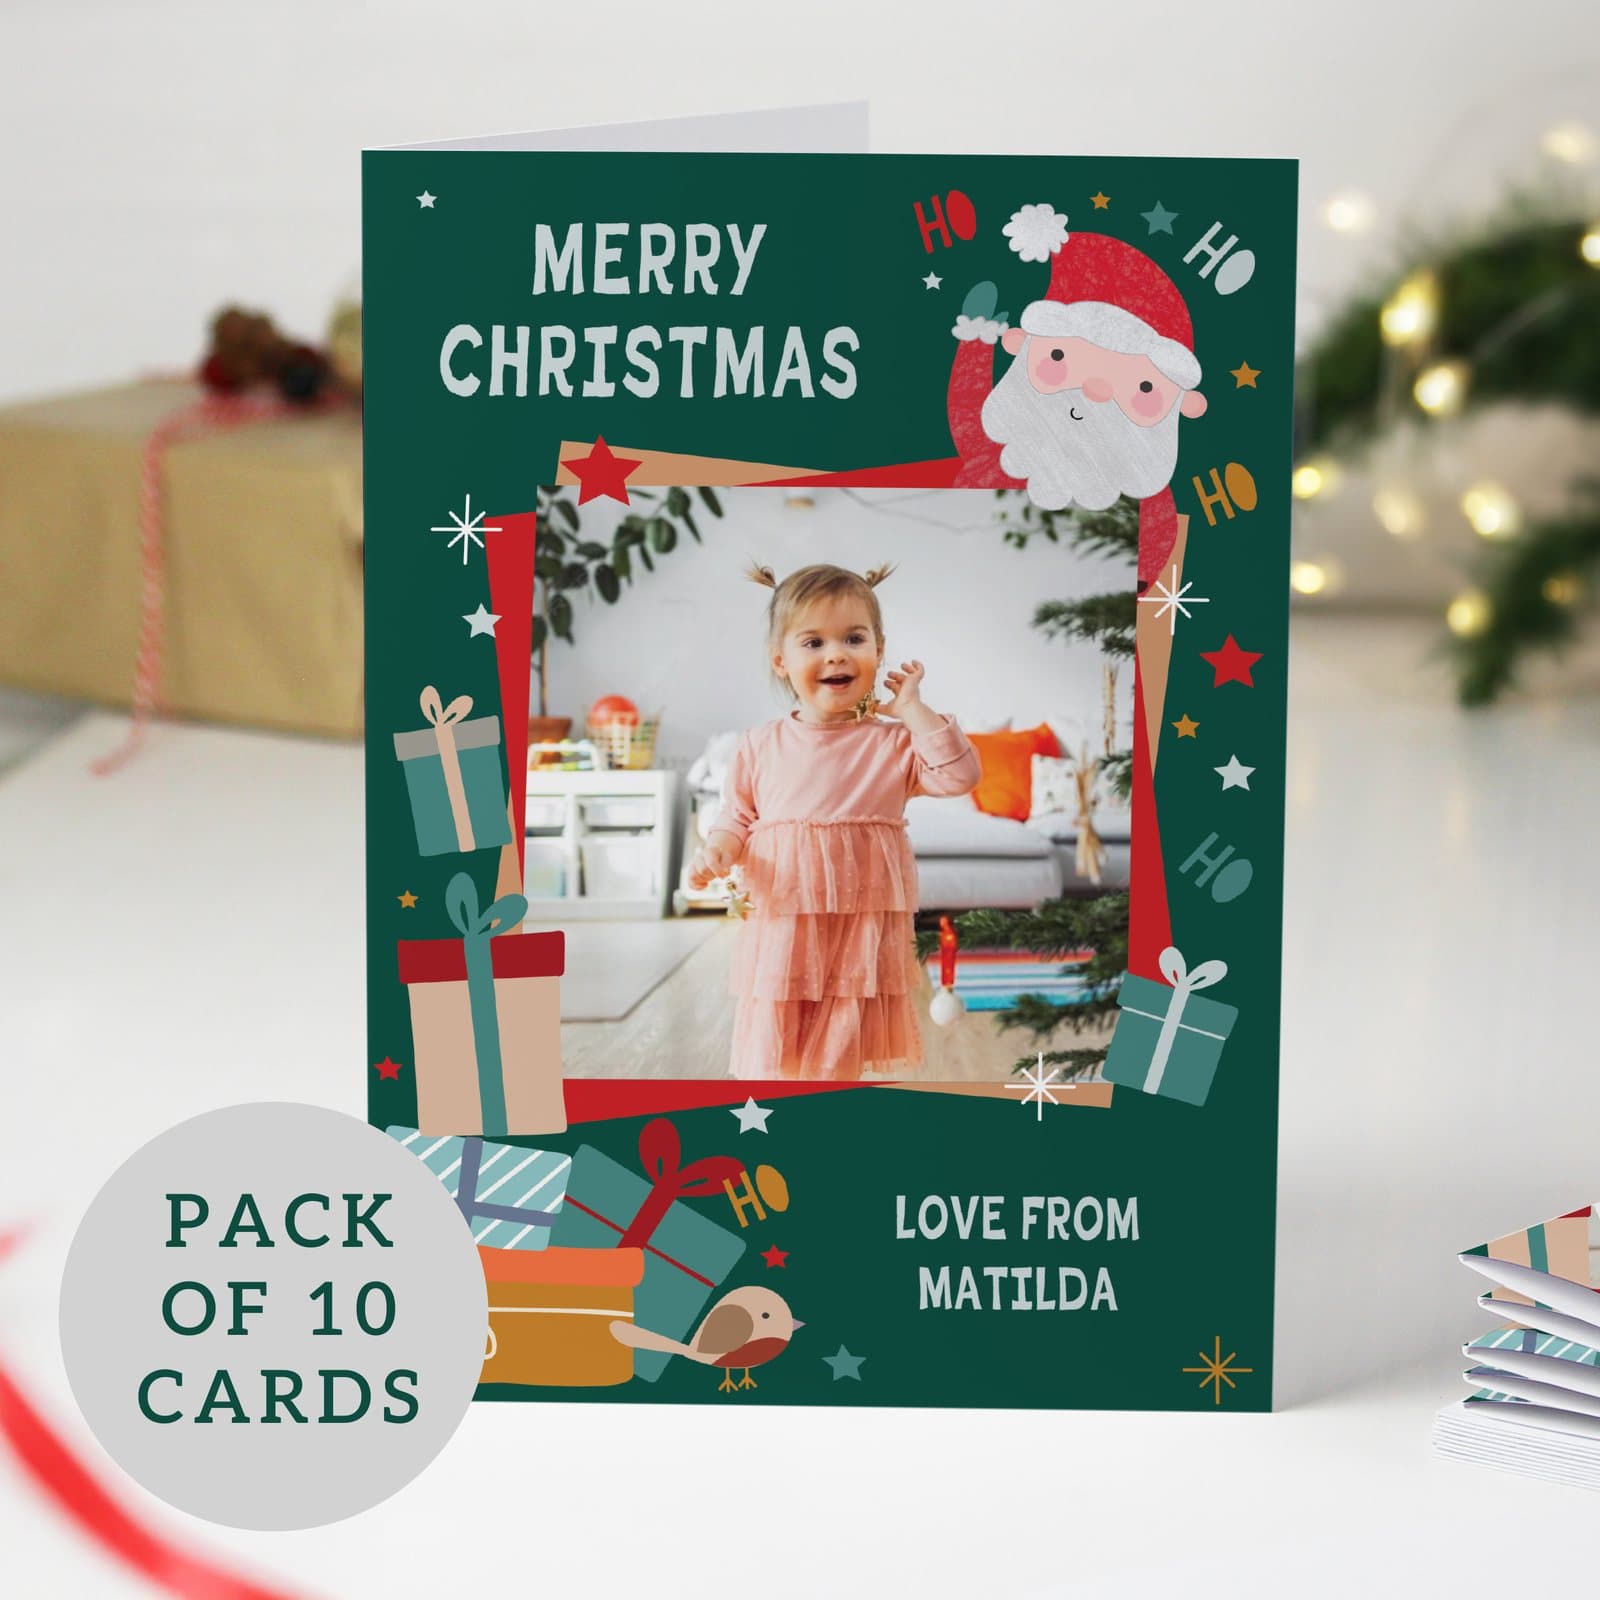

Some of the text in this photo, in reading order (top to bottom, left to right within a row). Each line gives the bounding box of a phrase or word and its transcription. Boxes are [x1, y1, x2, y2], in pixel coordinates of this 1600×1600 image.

[913, 189, 977, 254] HO
[532, 222, 768, 295] MERRY
[1182, 221, 1255, 295] HO
[440, 324, 860, 399] CHRISTMAS
[1192, 461, 1258, 526] HO
[1179, 832, 1253, 903] HO
[722, 1165, 788, 1227] HO
[896, 1195, 1140, 1241] LOVE FROM
[919, 1266, 1119, 1311] MATILDA
